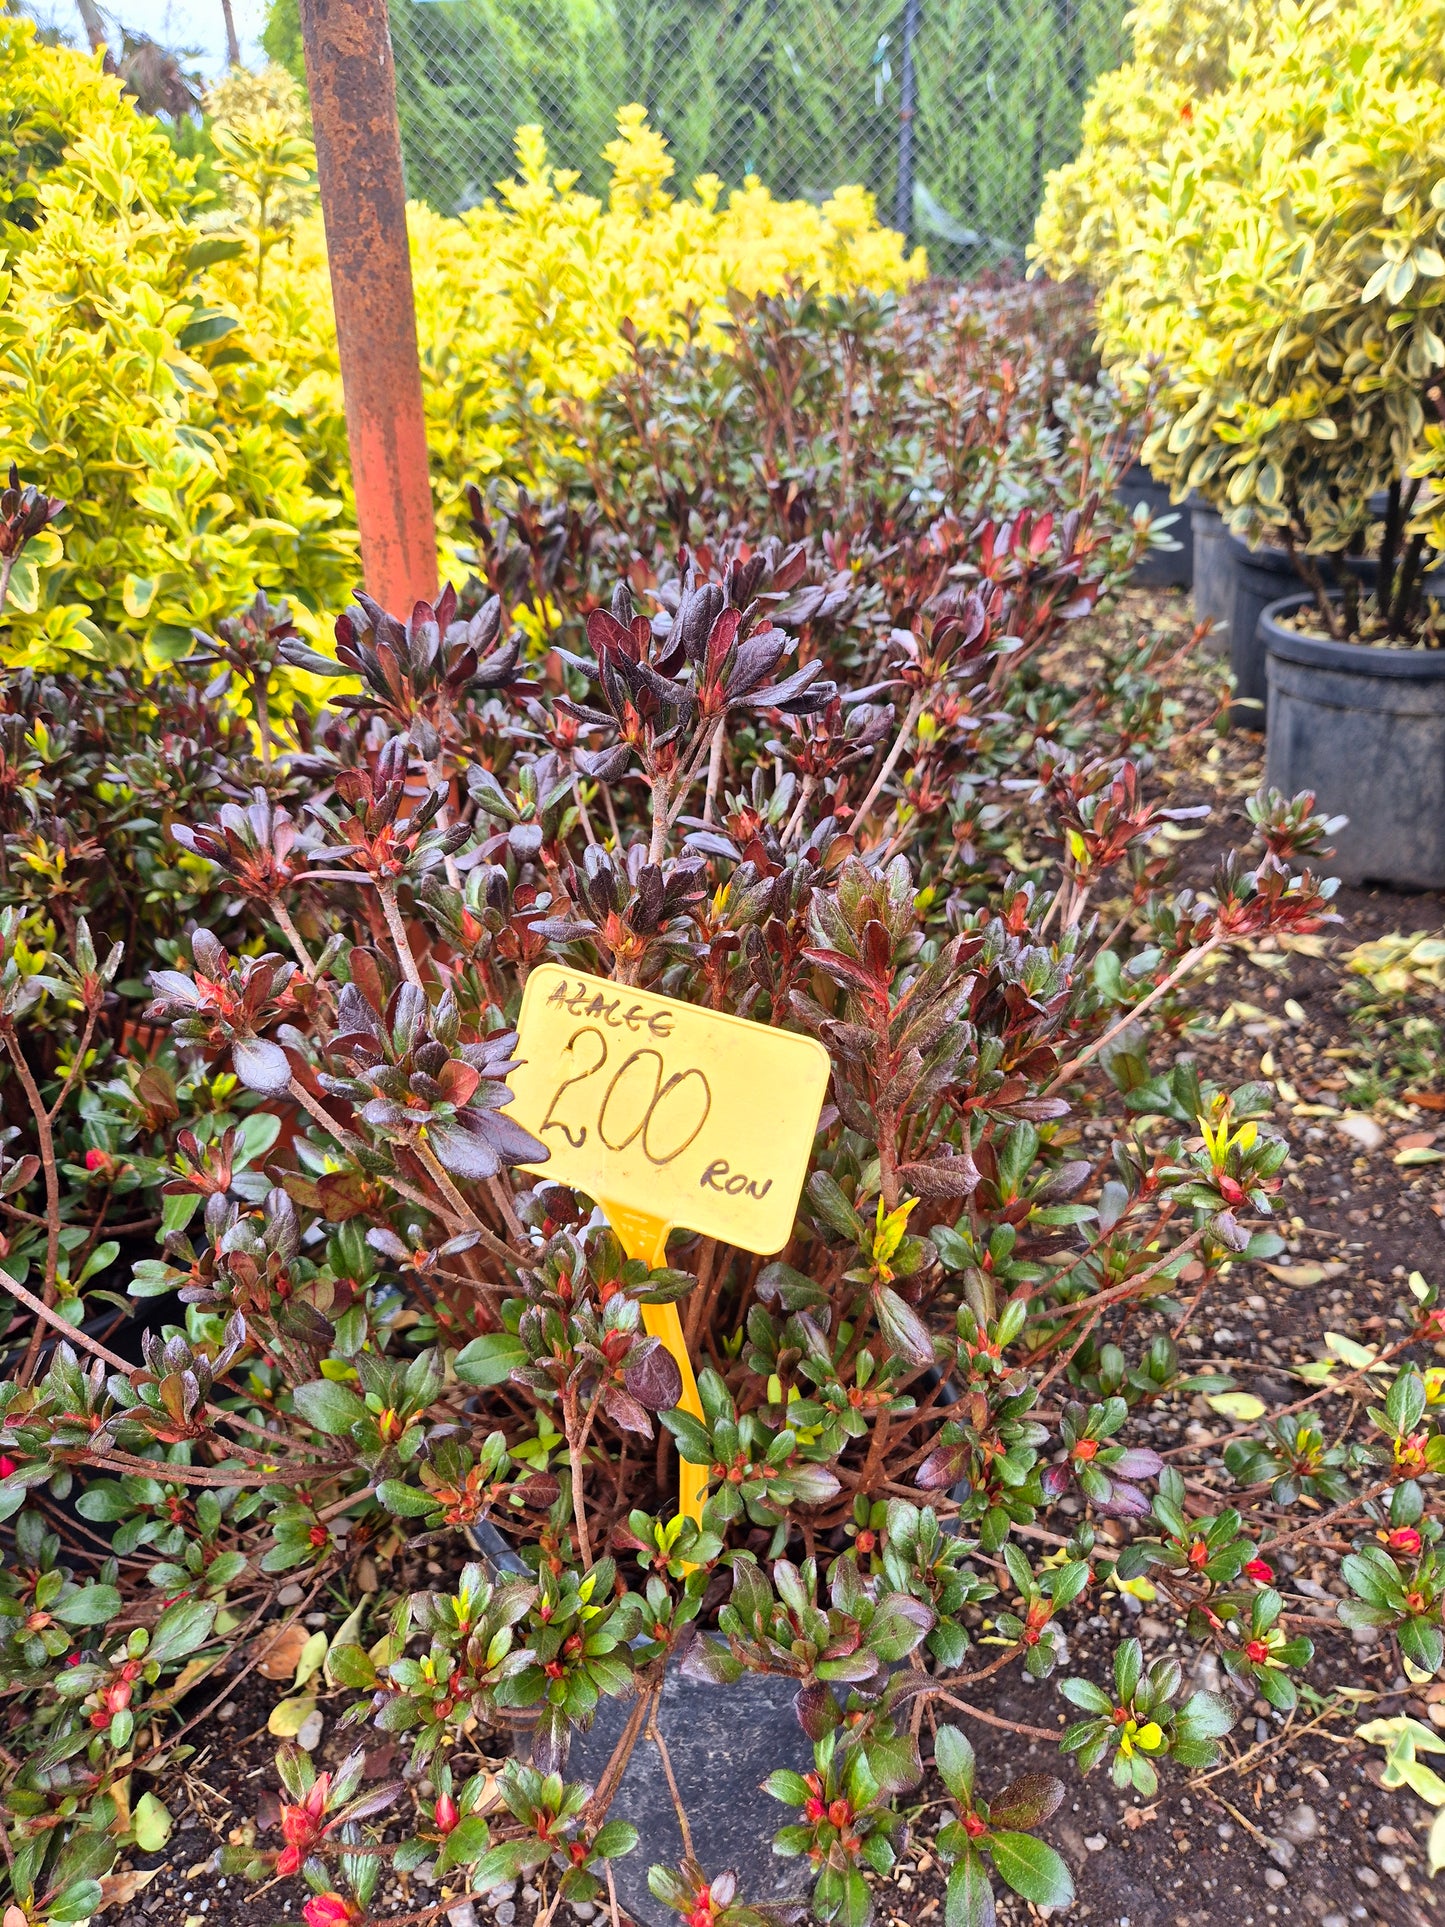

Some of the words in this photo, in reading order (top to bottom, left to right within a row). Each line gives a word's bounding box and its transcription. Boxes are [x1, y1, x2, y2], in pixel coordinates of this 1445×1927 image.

[546, 980, 676, 1038] AZALEE
[540, 1026, 711, 1165] 200
[700, 1158, 773, 1200] RON
